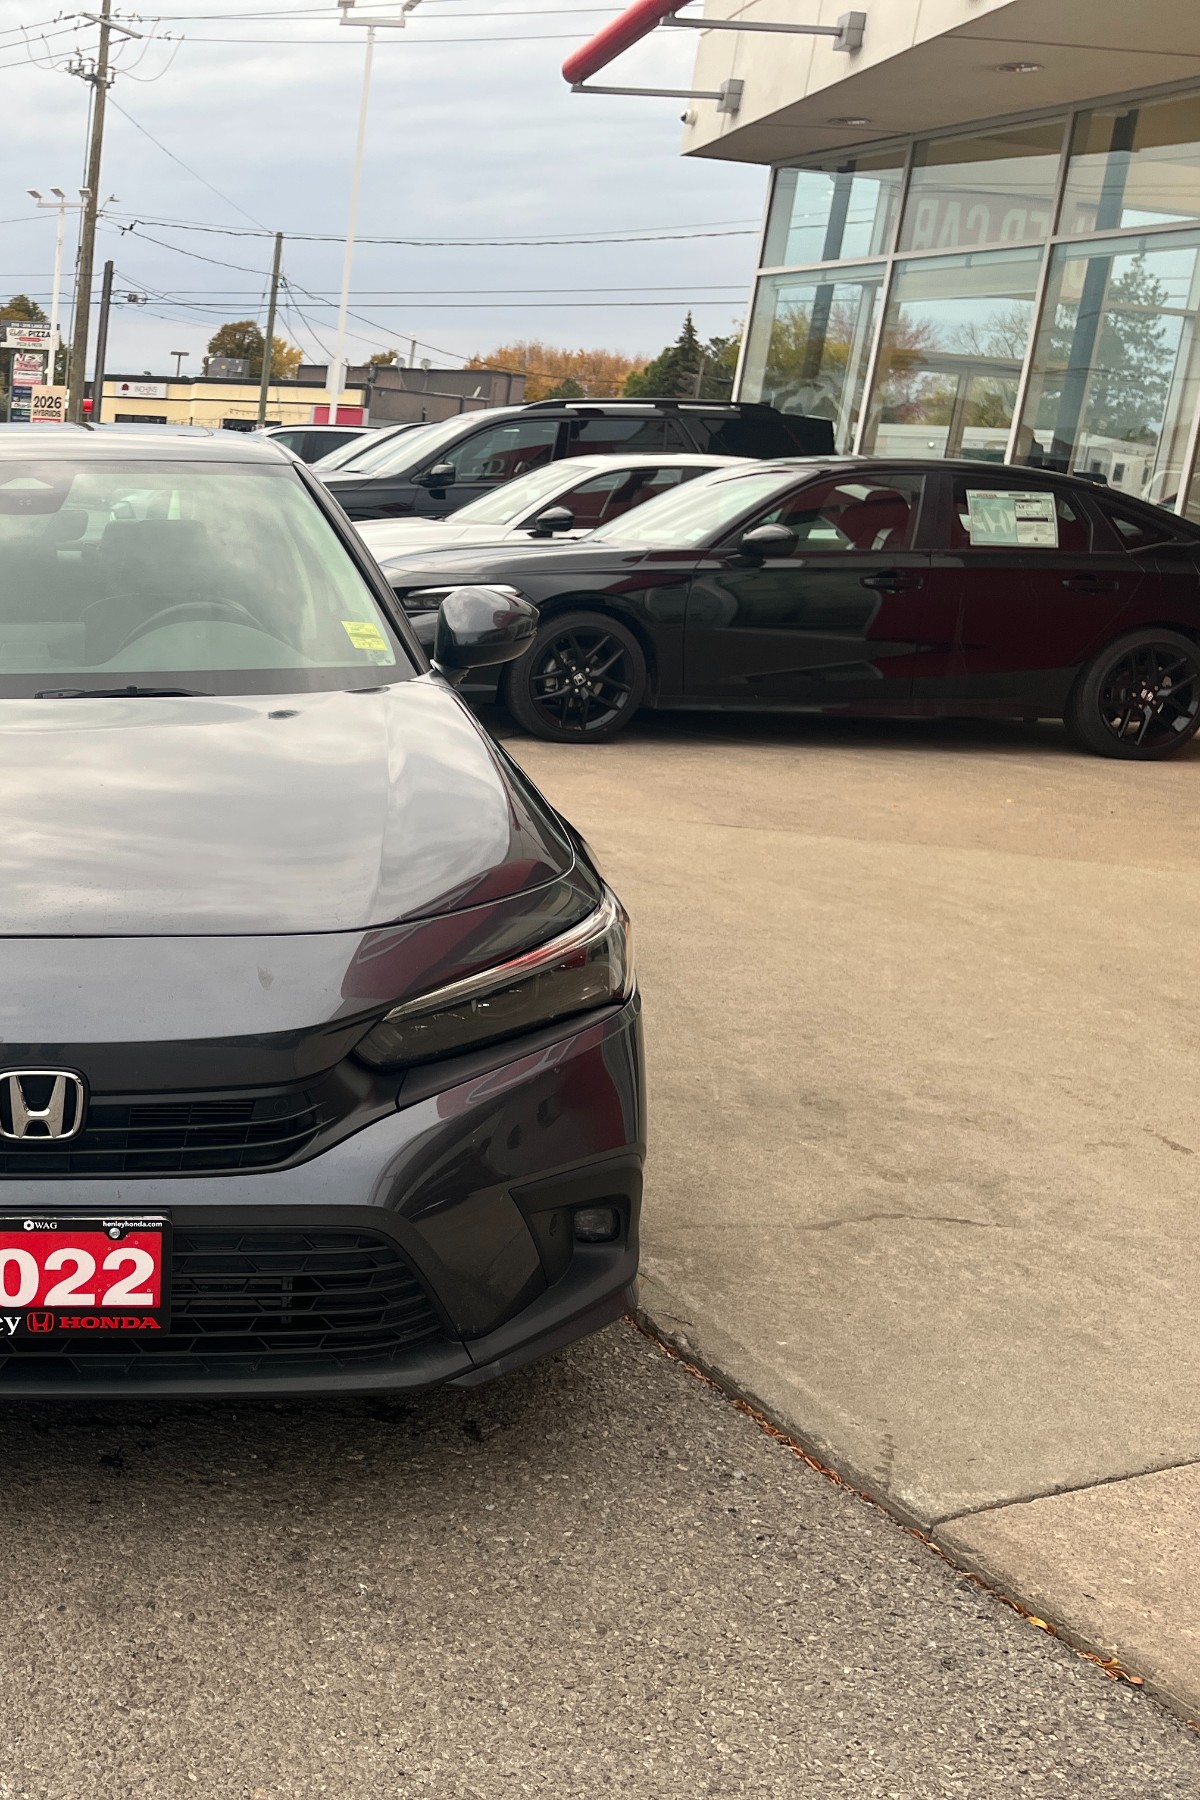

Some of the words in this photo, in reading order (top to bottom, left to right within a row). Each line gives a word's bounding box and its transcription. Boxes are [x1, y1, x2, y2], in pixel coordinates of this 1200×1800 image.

[28, 330, 51, 338] PIZZA
[33, 396, 62, 409] 2026
[32, 409, 62, 418] HYBRIDS
[35, 1221, 58, 1230] WAG
[102, 1220, 163, 1229] henleyhonda.com
[59, 1316, 161, 1329] HONDA
